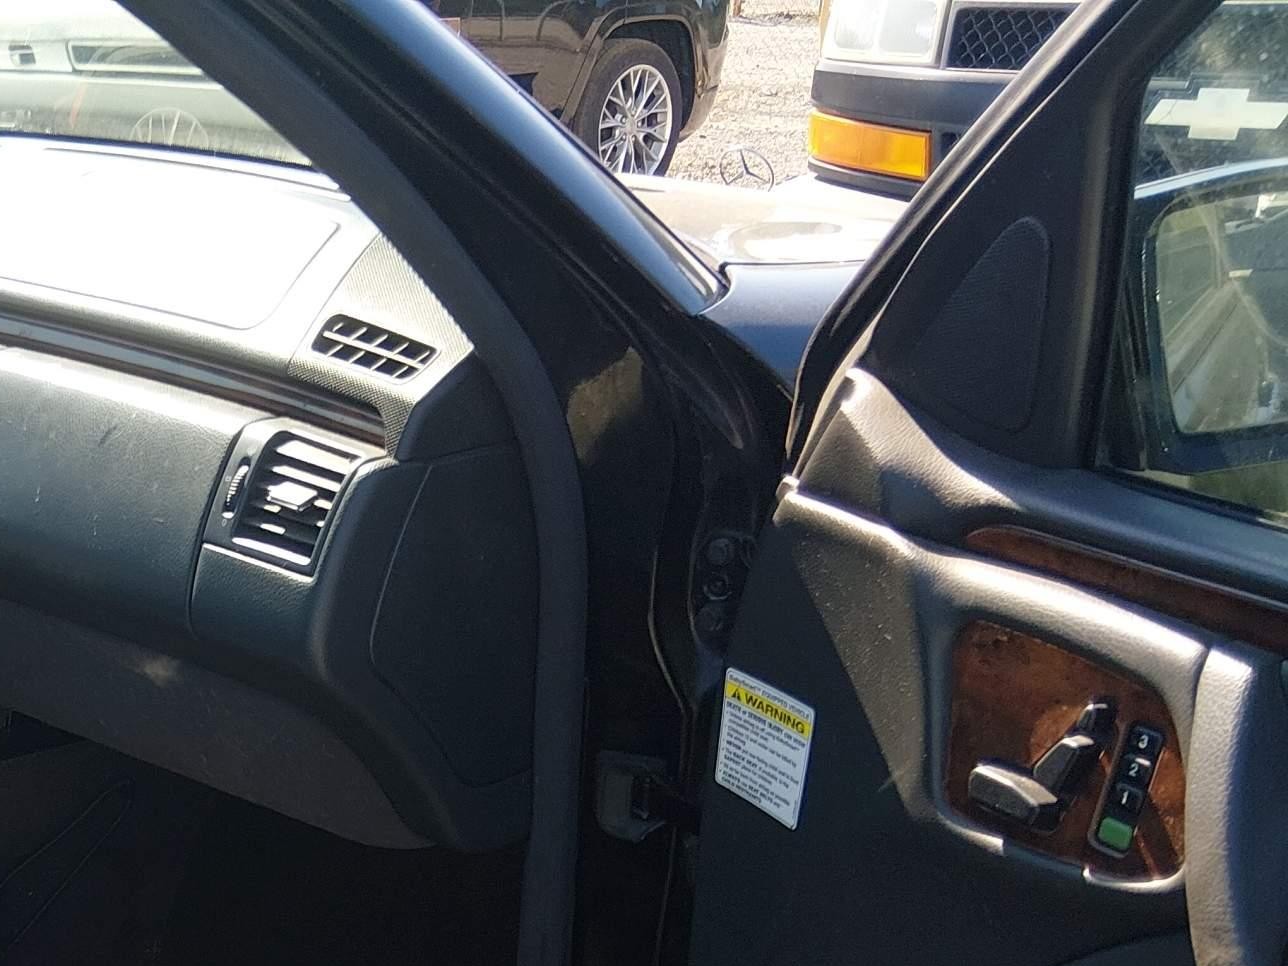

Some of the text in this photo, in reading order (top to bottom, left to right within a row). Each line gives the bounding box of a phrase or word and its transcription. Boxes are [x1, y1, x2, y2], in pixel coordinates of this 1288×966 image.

[744, 692, 805, 734] WARNING
[1138, 734, 1149, 749] 3
[1128, 762, 1139, 777] 2
[1121, 790, 1129, 805] 1
